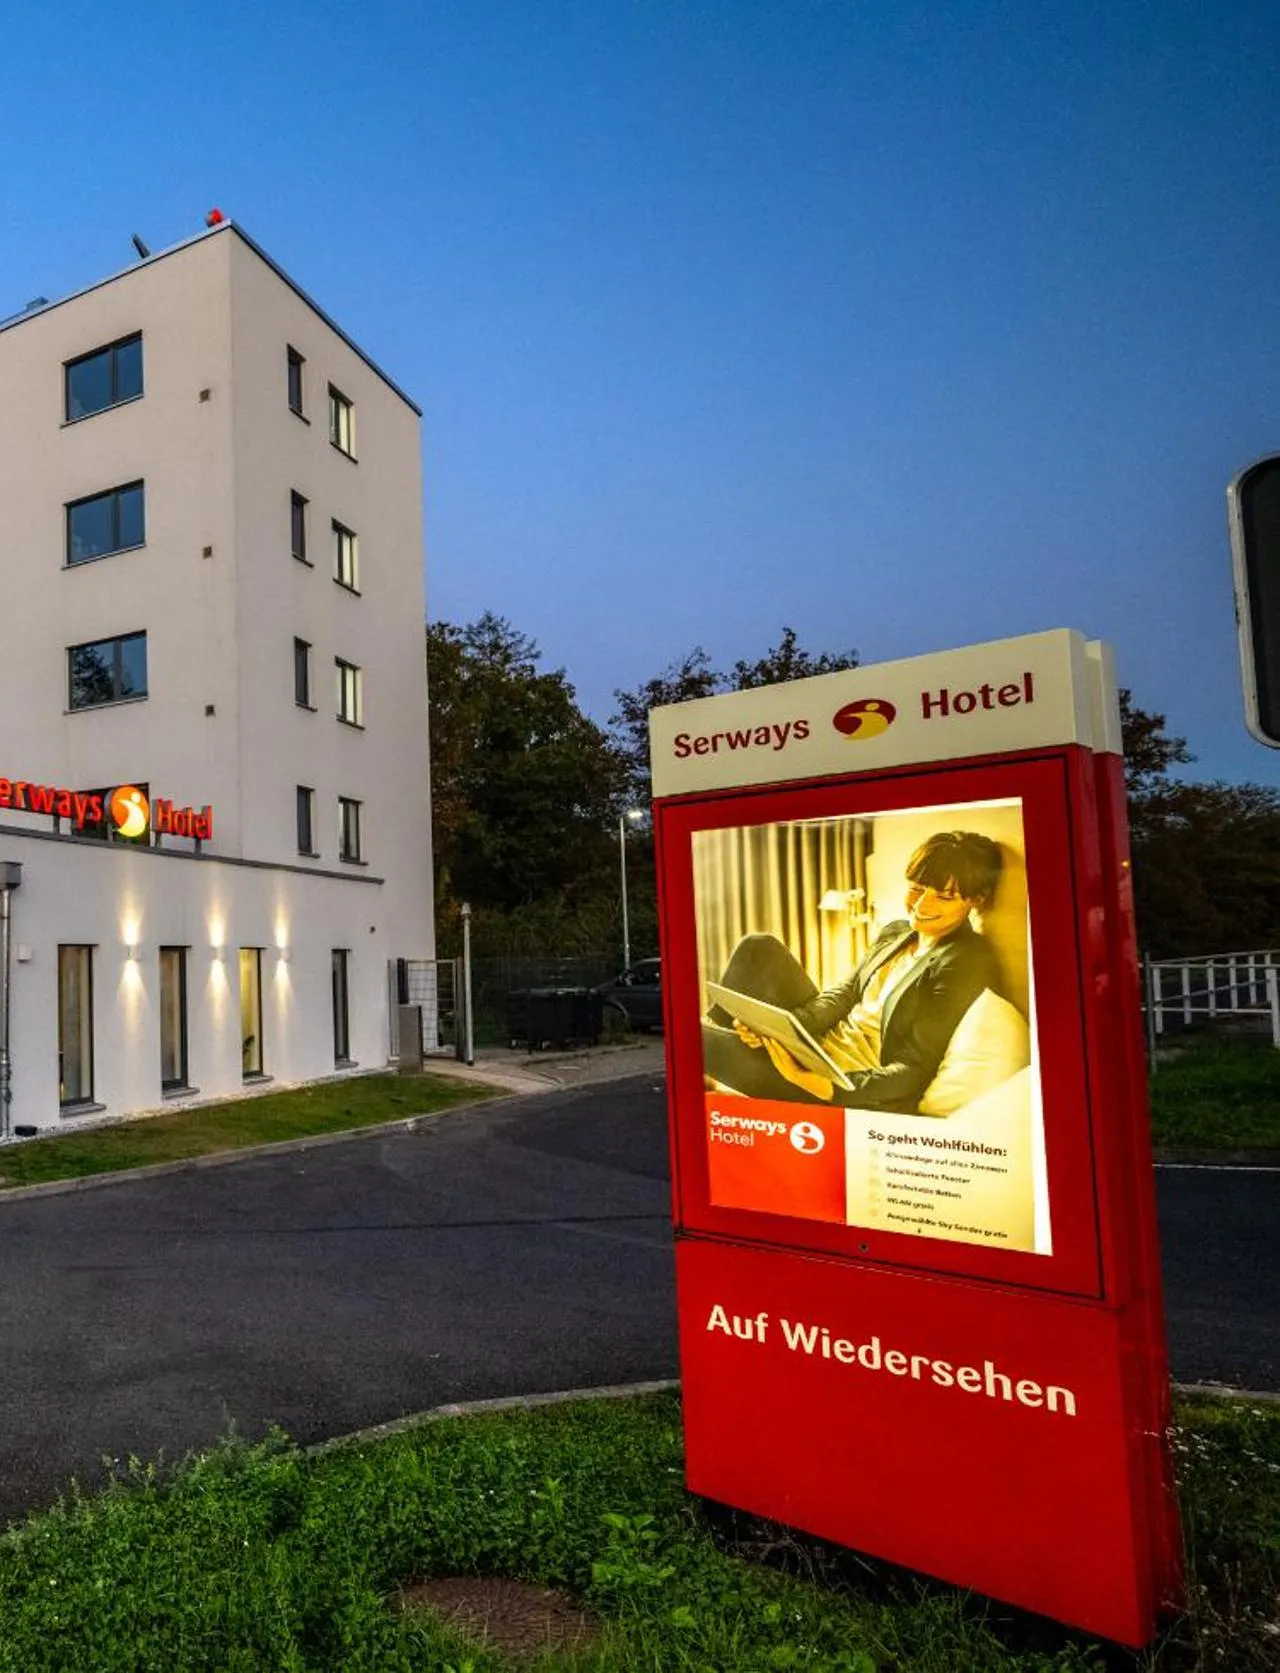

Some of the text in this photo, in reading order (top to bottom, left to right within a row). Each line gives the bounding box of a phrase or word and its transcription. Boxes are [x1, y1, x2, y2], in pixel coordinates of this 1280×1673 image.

[674, 672, 1034, 759] Serways Hotel
[154, 798, 213, 841] Hotel
[710, 1110, 787, 1136] Serways
[710, 1127, 754, 1147] Hotel
[868, 1129, 1008, 1157] So geht Wohlfühlen:
[707, 1304, 1077, 1417] Auf Wiedersehen
